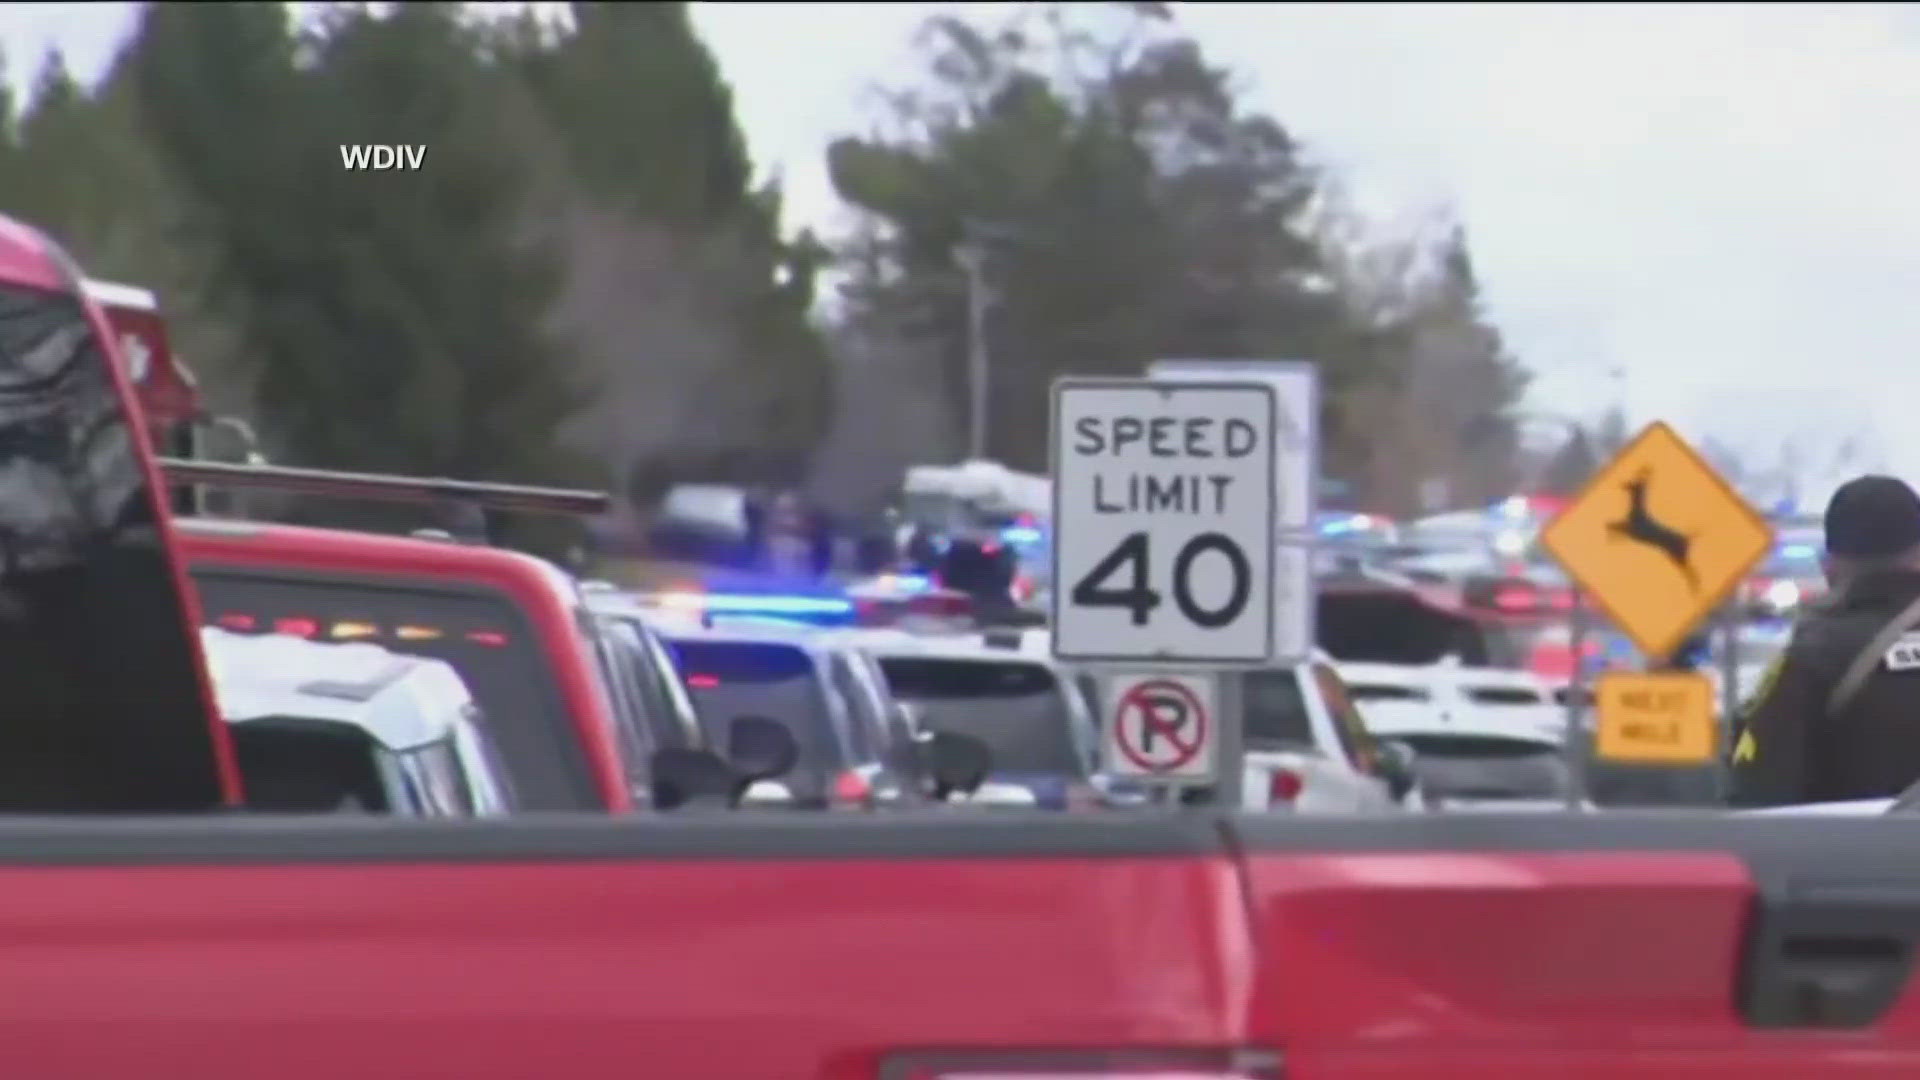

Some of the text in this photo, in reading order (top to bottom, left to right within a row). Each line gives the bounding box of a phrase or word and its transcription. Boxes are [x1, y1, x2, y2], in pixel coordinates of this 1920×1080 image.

[1074, 416, 1258, 459] SPEED
[1093, 472, 1234, 514] LIMIT
[1072, 530, 1252, 630] 40
